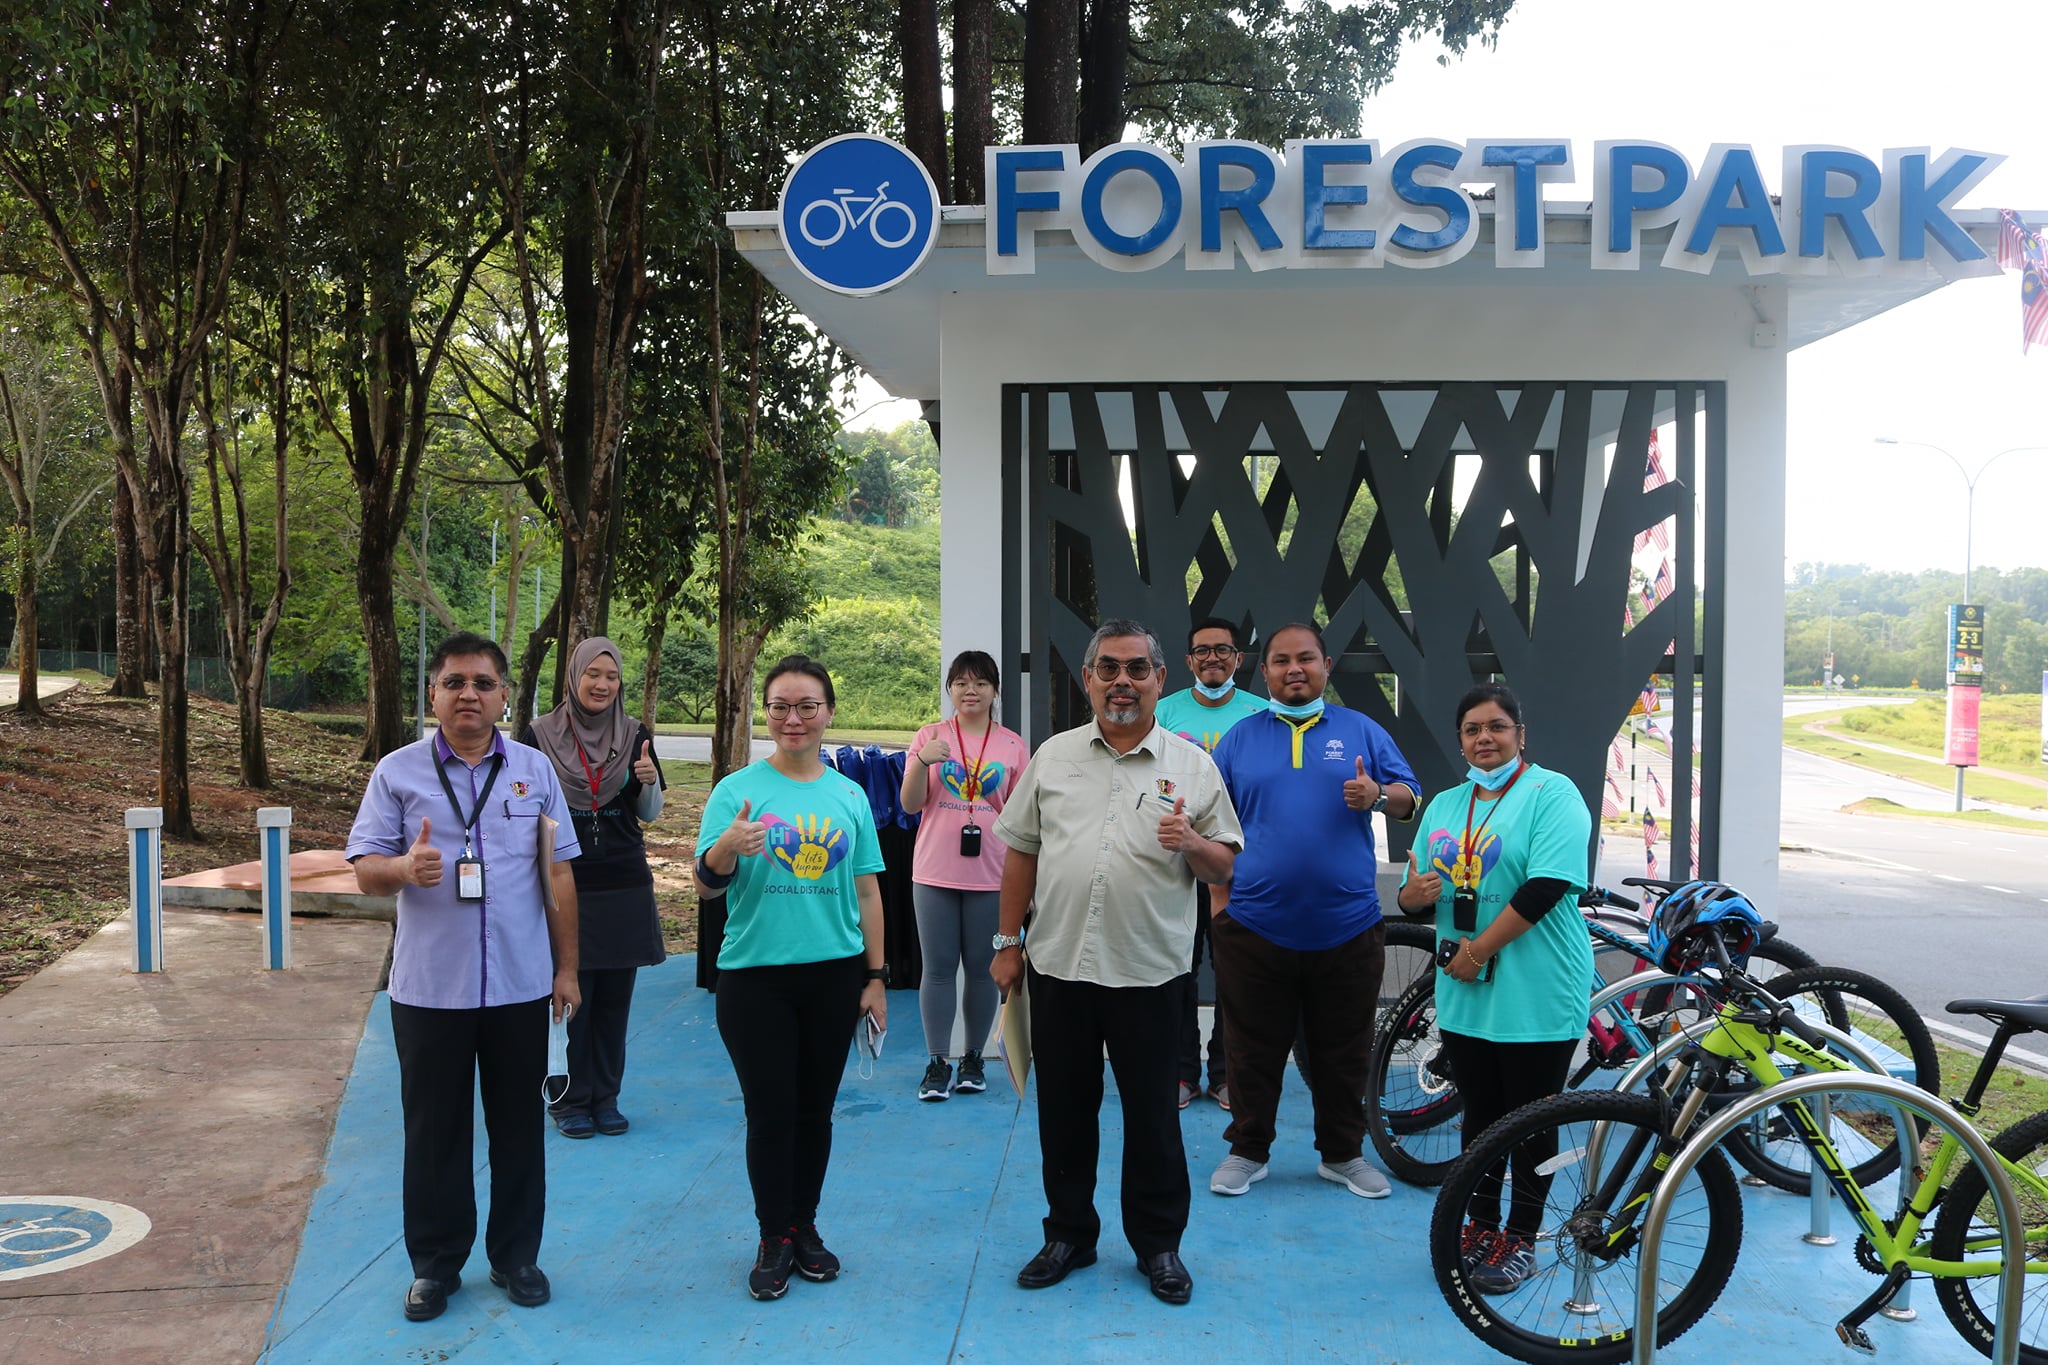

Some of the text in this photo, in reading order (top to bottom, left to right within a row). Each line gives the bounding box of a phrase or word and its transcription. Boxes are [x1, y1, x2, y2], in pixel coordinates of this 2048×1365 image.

[995, 144, 1988, 263] FOREST PARK
[939, 801, 961, 811] SOCIAL
[771, 827, 790, 845] Hi
[764, 885, 839, 895] SOCIAL DISTANC
[1384, 987, 1419, 1033] MAXXIS
[1450, 1268, 1492, 1329] MAXXIS
[1953, 1283, 1995, 1343] MAXXIS
